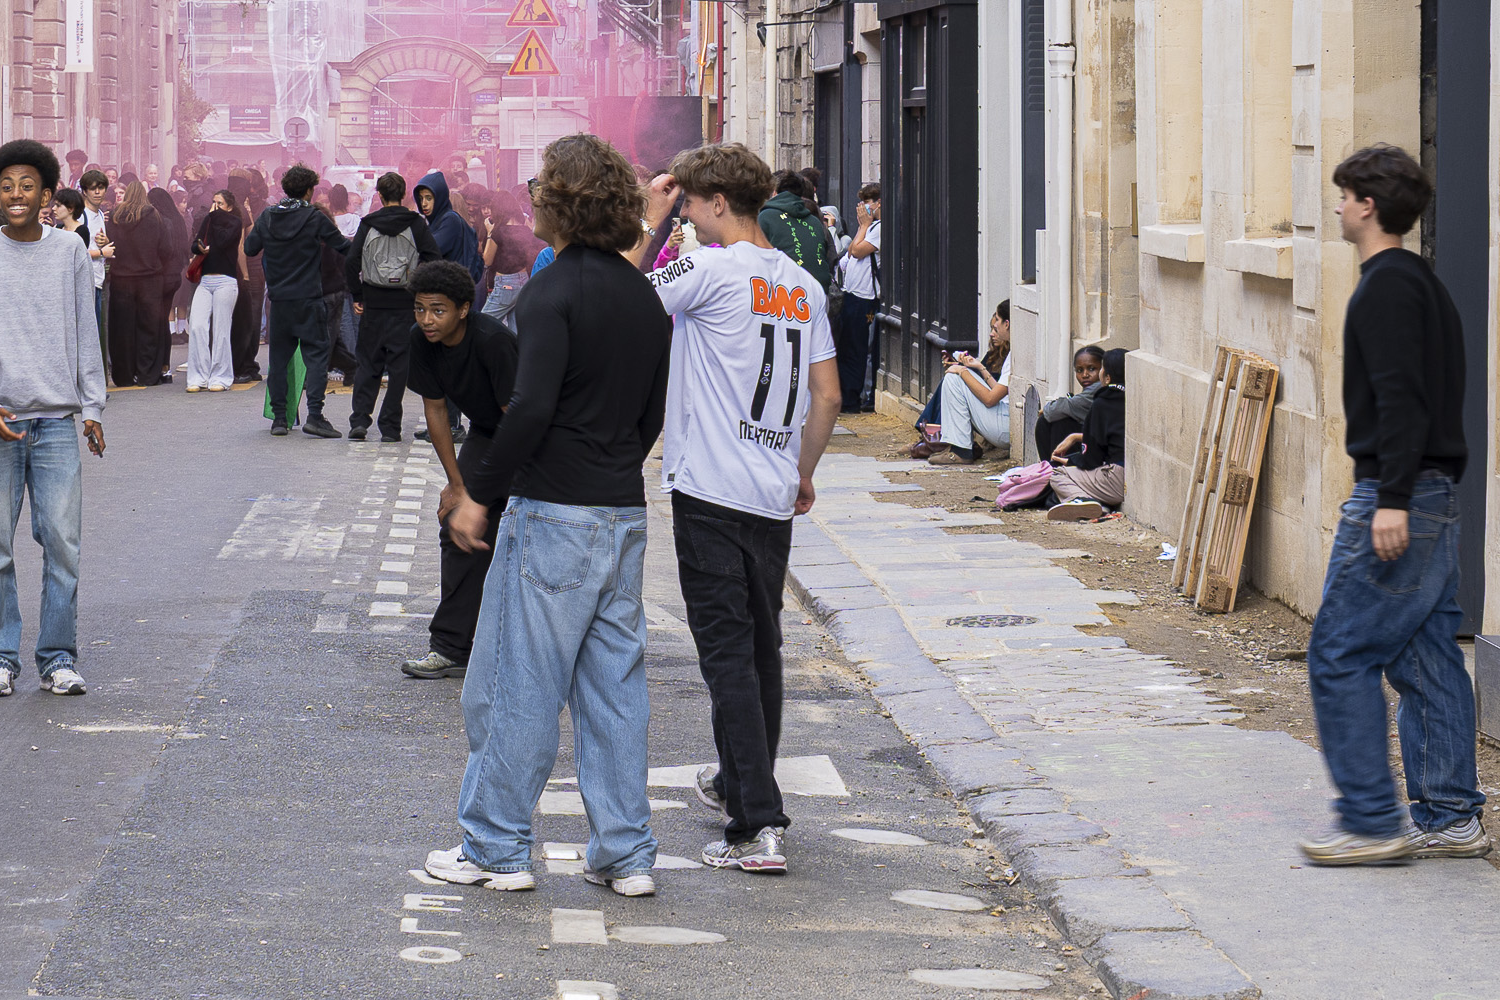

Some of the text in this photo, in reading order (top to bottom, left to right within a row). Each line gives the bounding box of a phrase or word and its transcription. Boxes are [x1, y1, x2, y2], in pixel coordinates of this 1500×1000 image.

[797, 218, 817, 237] YORK
[650, 256, 695, 288] ETSHOES
[750, 322, 802, 427] 11
[763, 363, 771, 377] CSU
